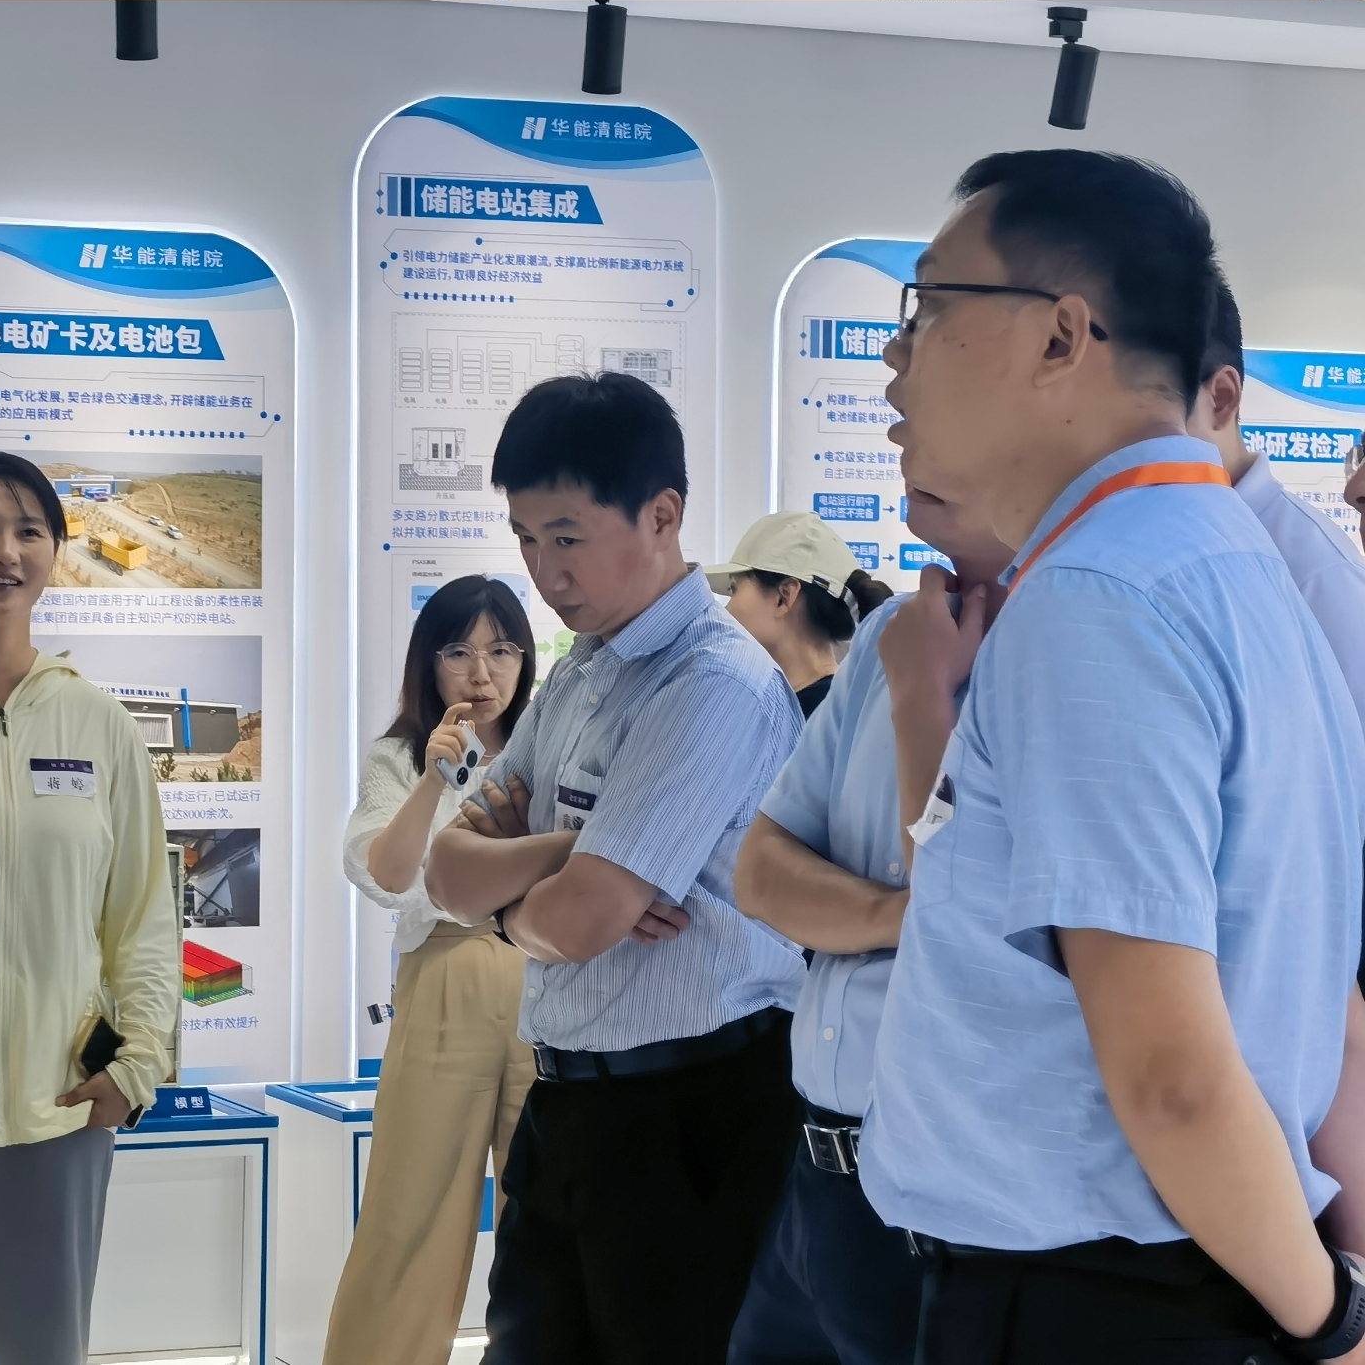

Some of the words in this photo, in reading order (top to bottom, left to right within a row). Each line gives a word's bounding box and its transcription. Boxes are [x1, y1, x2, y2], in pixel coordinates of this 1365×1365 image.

[550, 118, 653, 141] 华能清能院
[420, 184, 580, 219] 储能电站集成
[112, 243, 224, 269] 华能清能院
[1326, 366, 1365, 385] 华能
[824, 450, 901, 465] 电芯级安全智能
[175, 1096, 205, 1110] 模型
